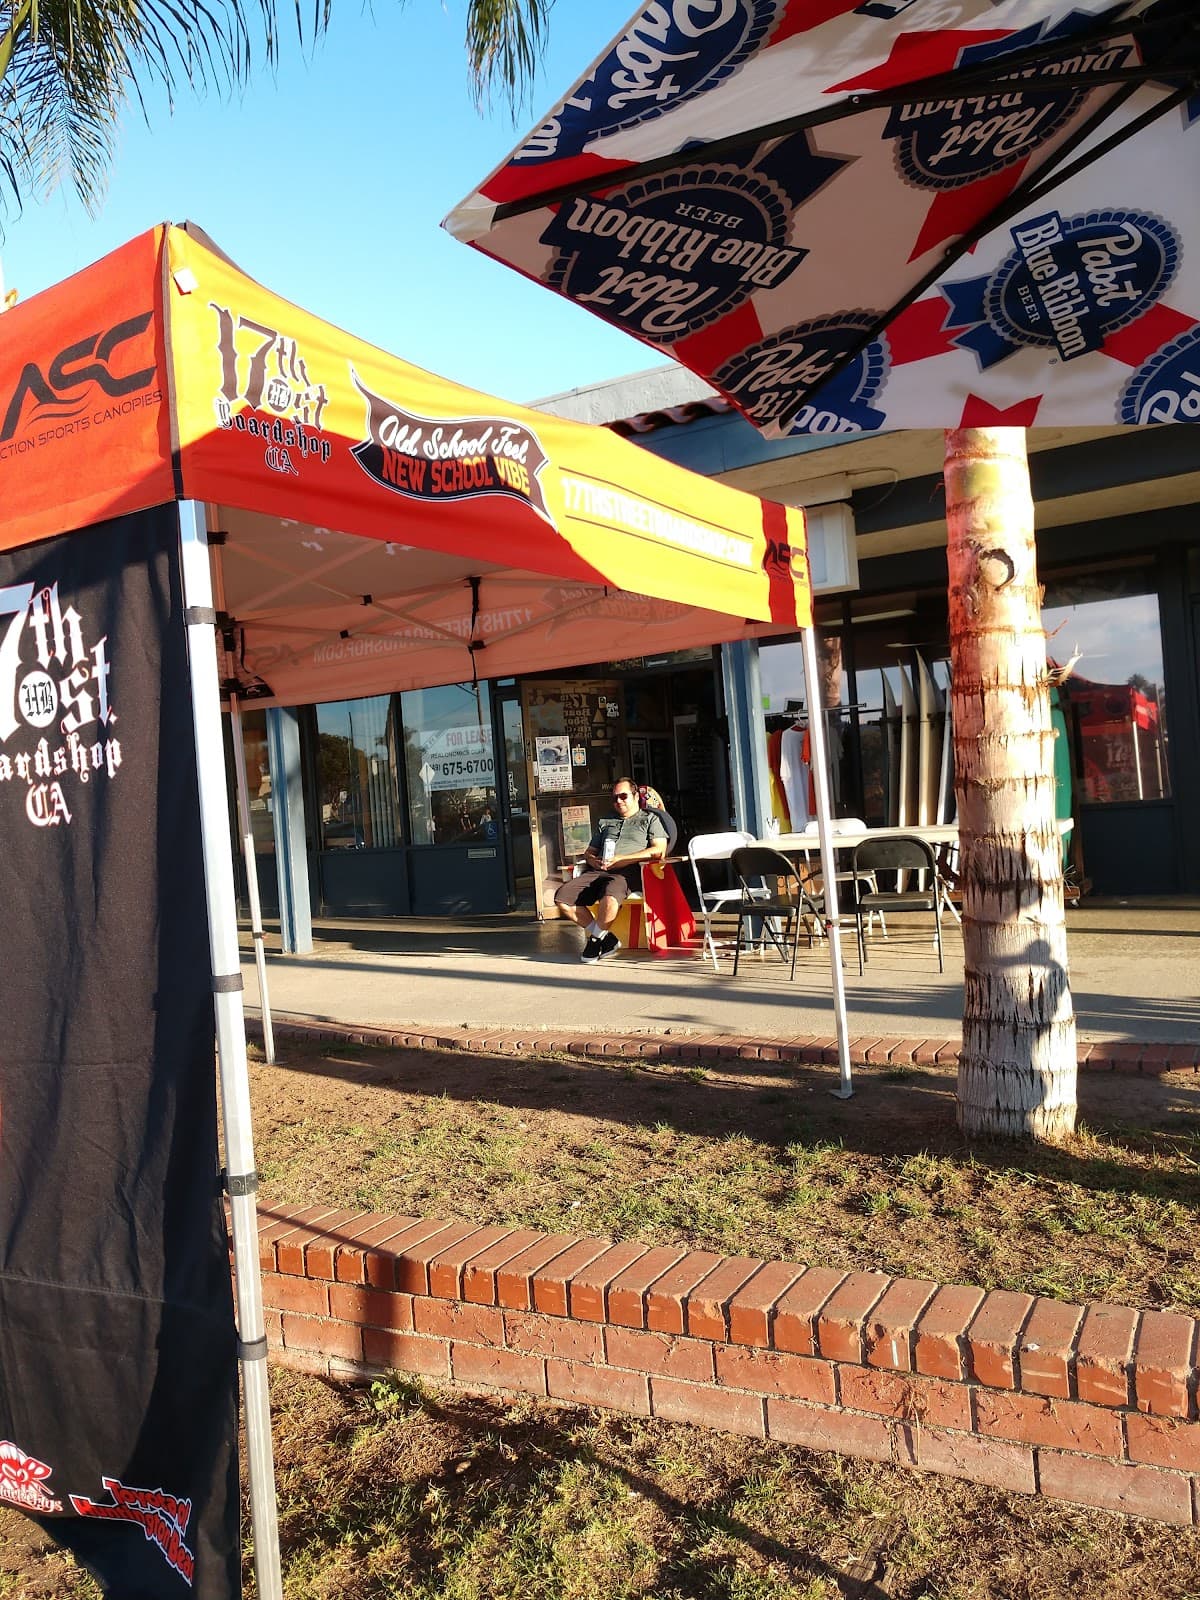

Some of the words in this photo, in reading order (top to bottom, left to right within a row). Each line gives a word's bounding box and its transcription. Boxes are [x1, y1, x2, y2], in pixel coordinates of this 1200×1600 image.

[928, 101, 1055, 166] Pabst
[566, 197, 719, 272] Ribbon
[674, 202, 745, 229] BEER
[711, 237, 801, 287] Blue
[1016, 217, 1063, 281] Blue
[1076, 222, 1143, 307] Pabst
[575, 265, 719, 333] Pabst
[1017, 284, 1041, 324] BEER
[1037, 271, 1090, 358] Ribbon
[0, 311, 157, 442] ASC
[209, 302, 311, 412] 17th
[727, 342, 849, 394] Pabs
[0, 437, 35, 459] CTION
[38, 415, 91, 446] SPORTS
[93, 389, 163, 425] CANOPIES
[215, 398, 332, 463] Boardshop
[379, 415, 422, 456] Old
[423, 426, 493, 460] School
[491, 426, 529, 464] Feel
[265, 446, 299, 476] CA
[381, 445, 427, 492] NEW
[431, 456, 494, 494] SCHOOL
[493, 456, 531, 497] VIBE
[761, 538, 804, 579] ASC
[0, 580, 89, 742] 7th
[0, 732, 122, 784] ardshop
[446, 731, 464, 747] FOR
[442, 758, 494, 776] 675-6700
[26, 781, 73, 827] CA
